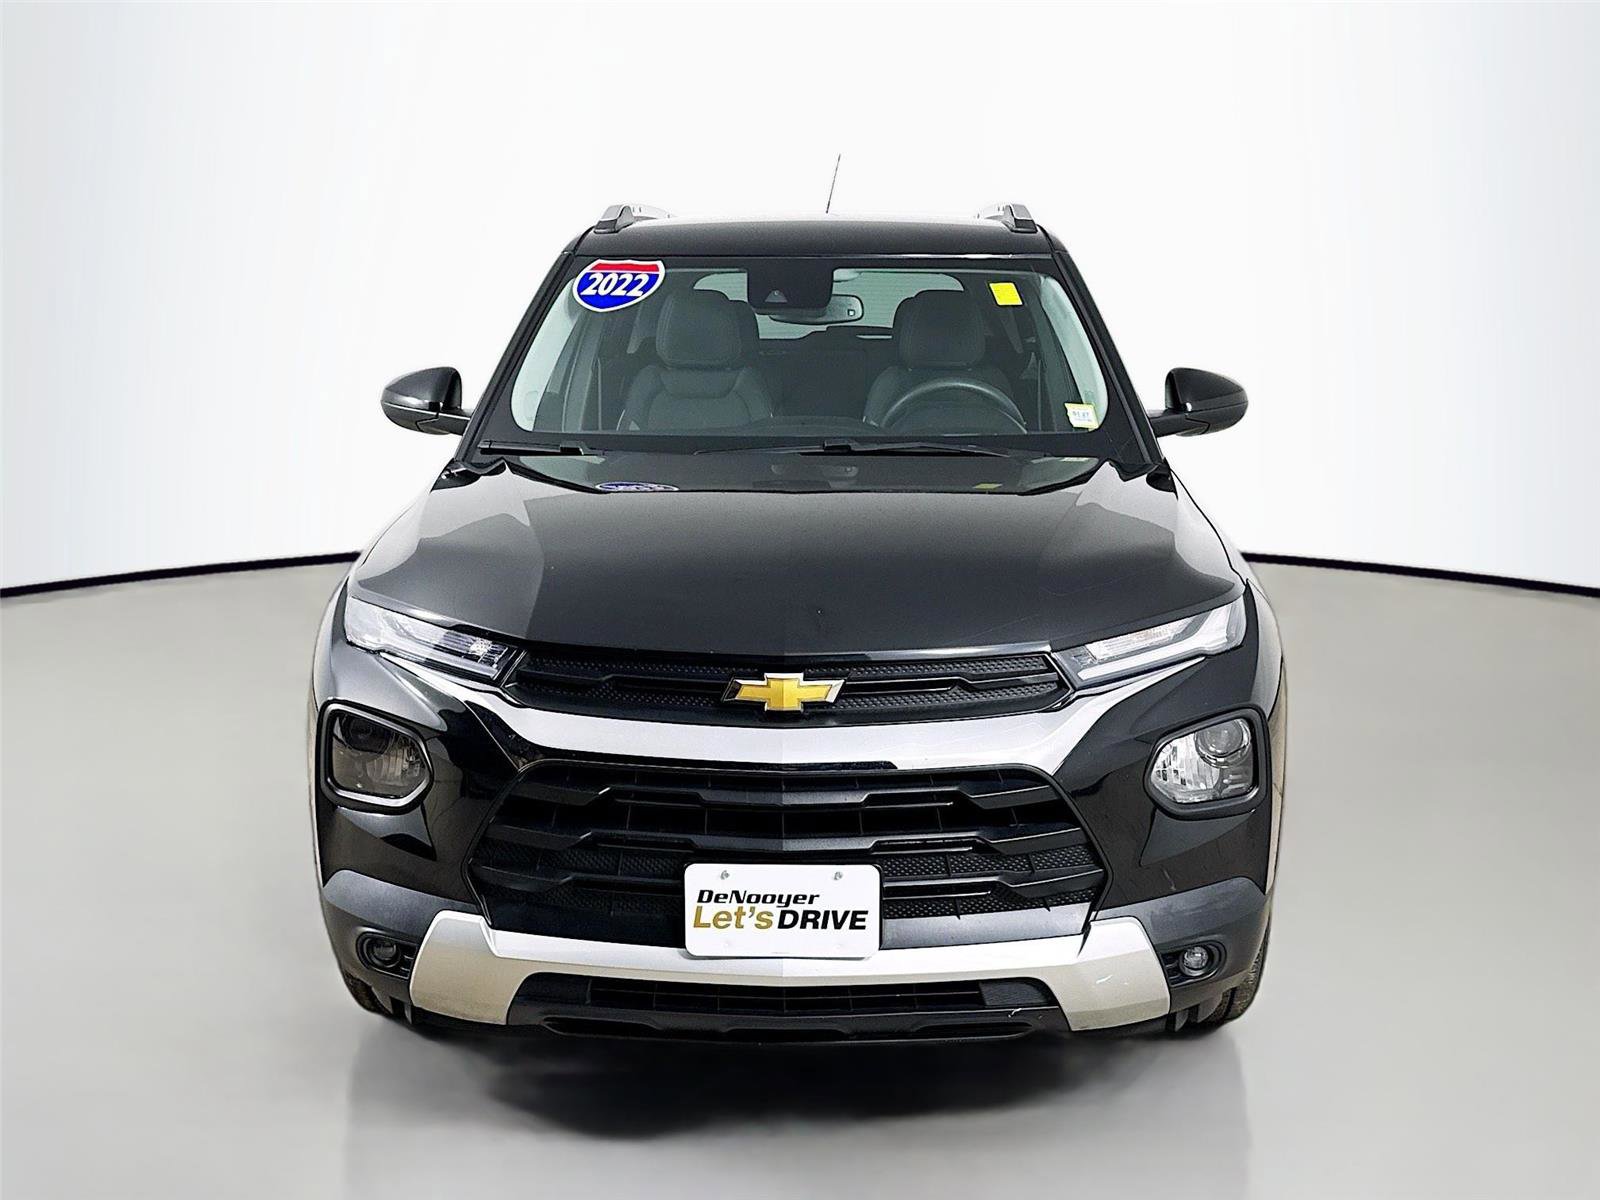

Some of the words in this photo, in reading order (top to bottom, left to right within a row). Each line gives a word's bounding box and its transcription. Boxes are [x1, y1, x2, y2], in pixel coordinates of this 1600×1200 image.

[580, 272, 649, 297] 2022
[697, 889, 820, 908] DeNooyer
[693, 905, 774, 930] Let's
[777, 910, 869, 930] DRIVE
